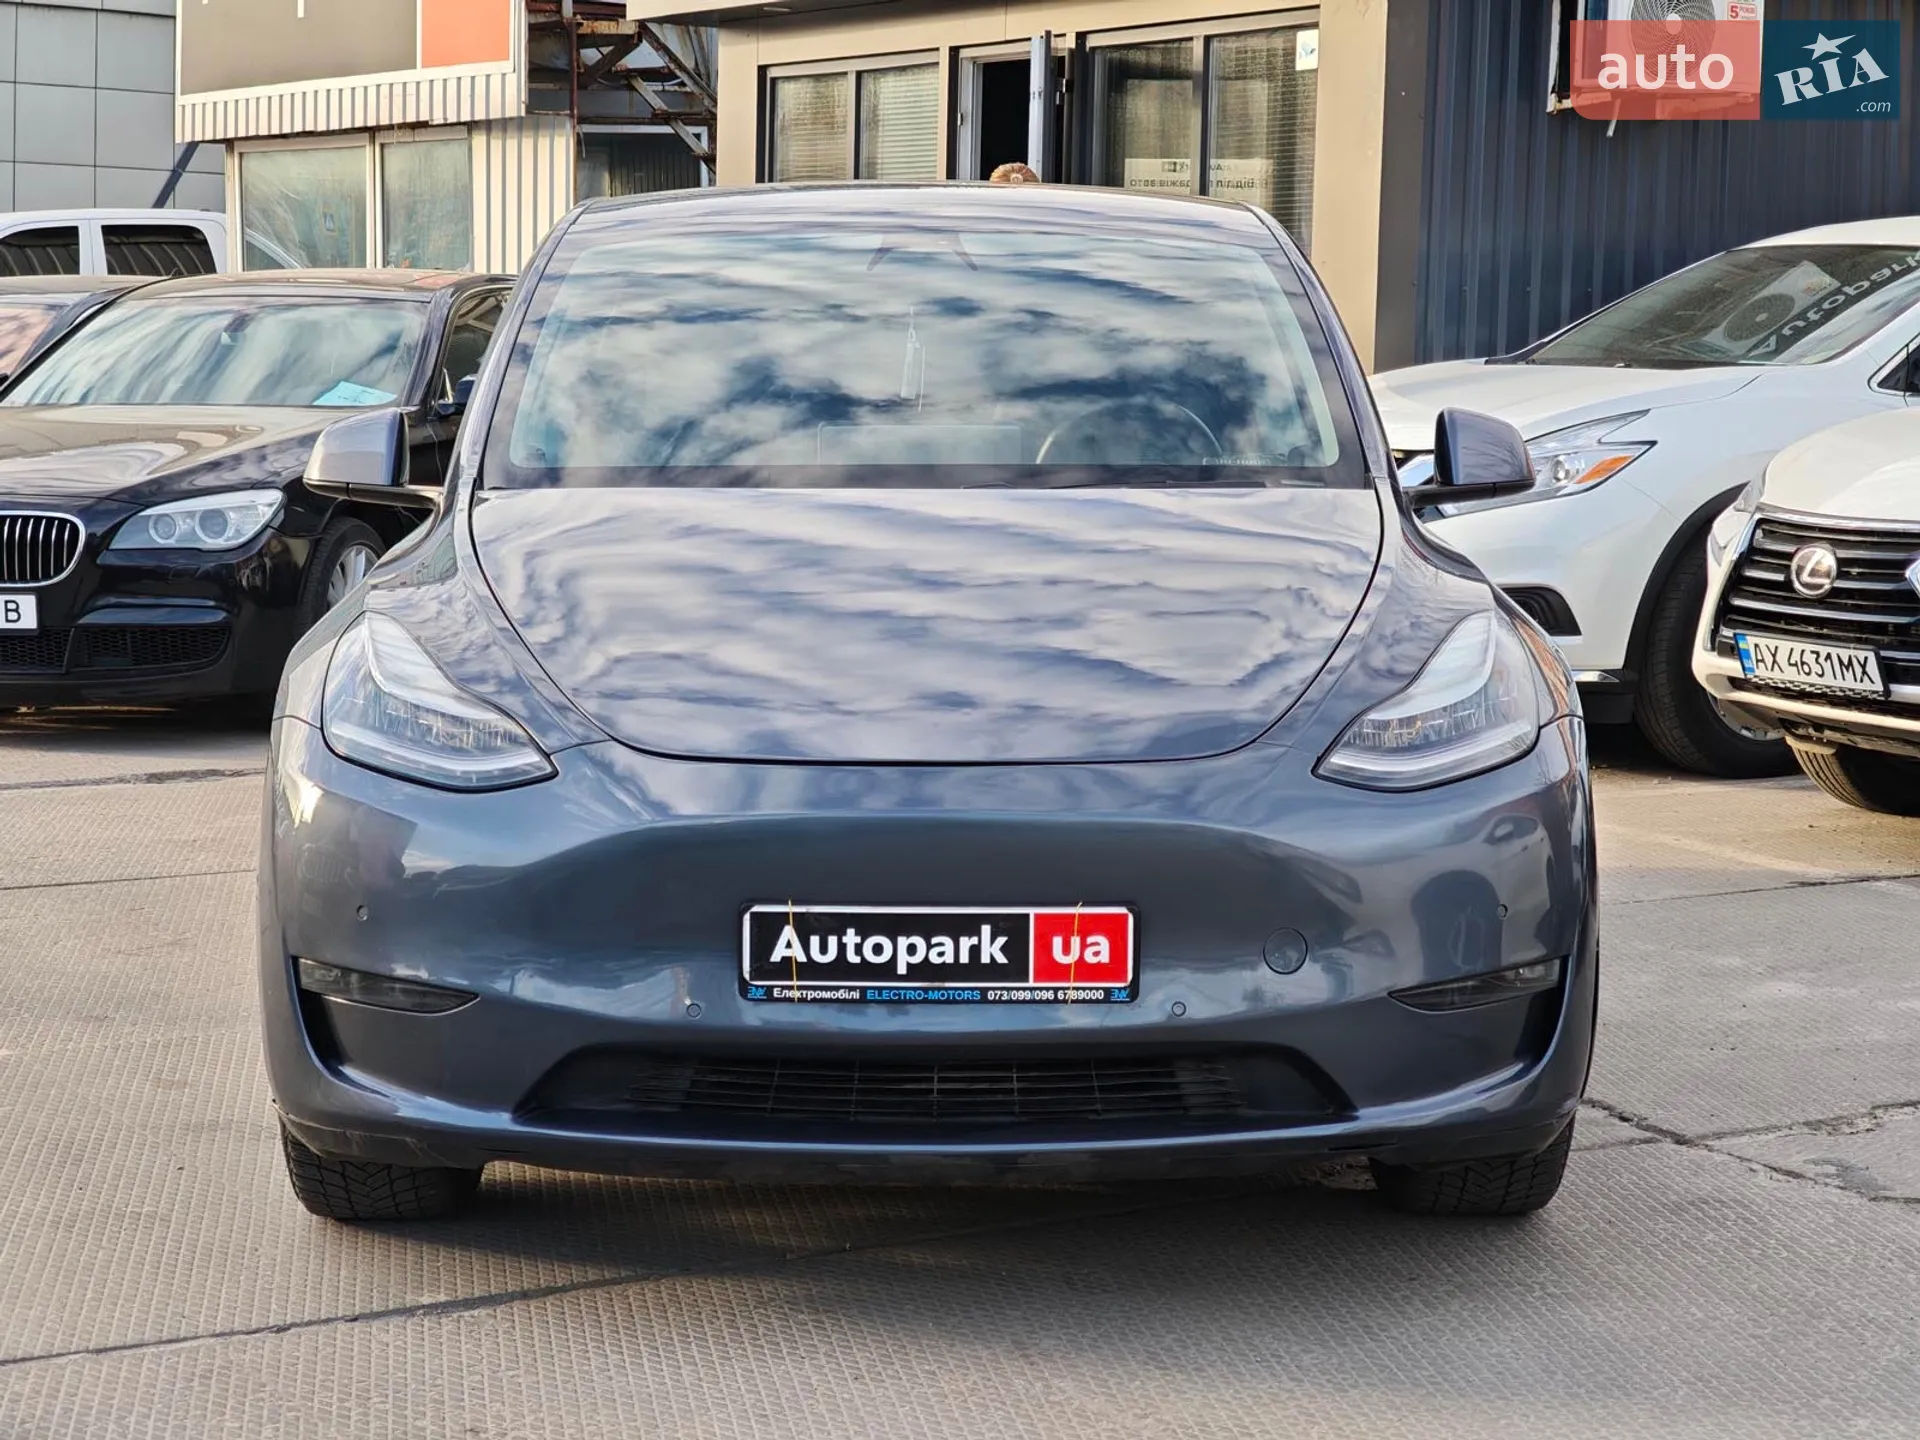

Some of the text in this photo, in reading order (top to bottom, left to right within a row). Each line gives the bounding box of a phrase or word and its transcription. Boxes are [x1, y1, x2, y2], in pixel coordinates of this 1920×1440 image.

[4, 599, 21, 623] B
[1754, 642, 1784, 674] AX
[769, 924, 1110, 975] Autopark ua
[773, 987, 860, 1000] Електромобілі
[866, 989, 981, 1001] ELECTRO-MOTORS
[987, 989, 1055, 1001] 073/099/096
[1057, 989, 1104, 1001] 6789000
